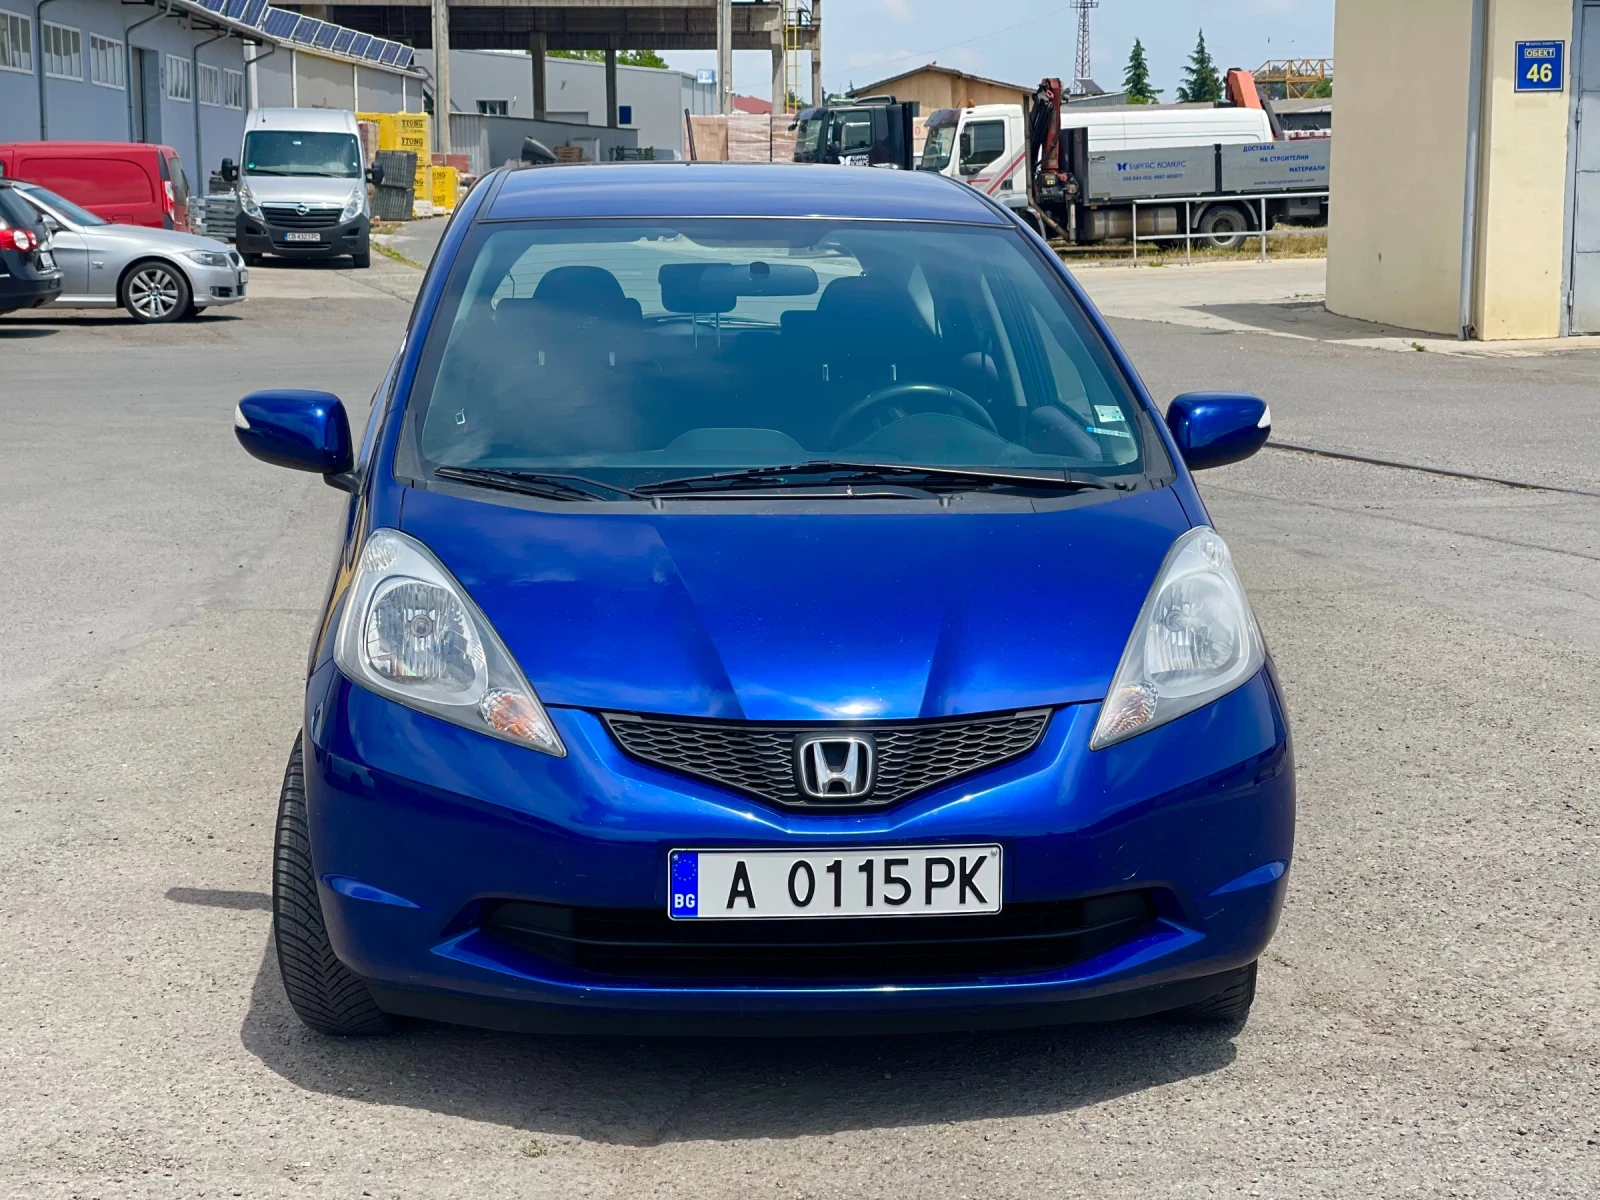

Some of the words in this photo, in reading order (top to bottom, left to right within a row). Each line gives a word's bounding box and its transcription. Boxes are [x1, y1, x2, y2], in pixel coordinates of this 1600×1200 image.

[1526, 49, 1554, 57] ОБЕКТ
[1526, 63, 1553, 83] 46
[401, 119, 423, 127] YTONG
[401, 137, 423, 146] YTONG
[1129, 162, 1155, 170] БУРГАС
[1157, 161, 1186, 169] КОМЕРС
[726, 860, 756, 909] A
[674, 894, 696, 909] BG
